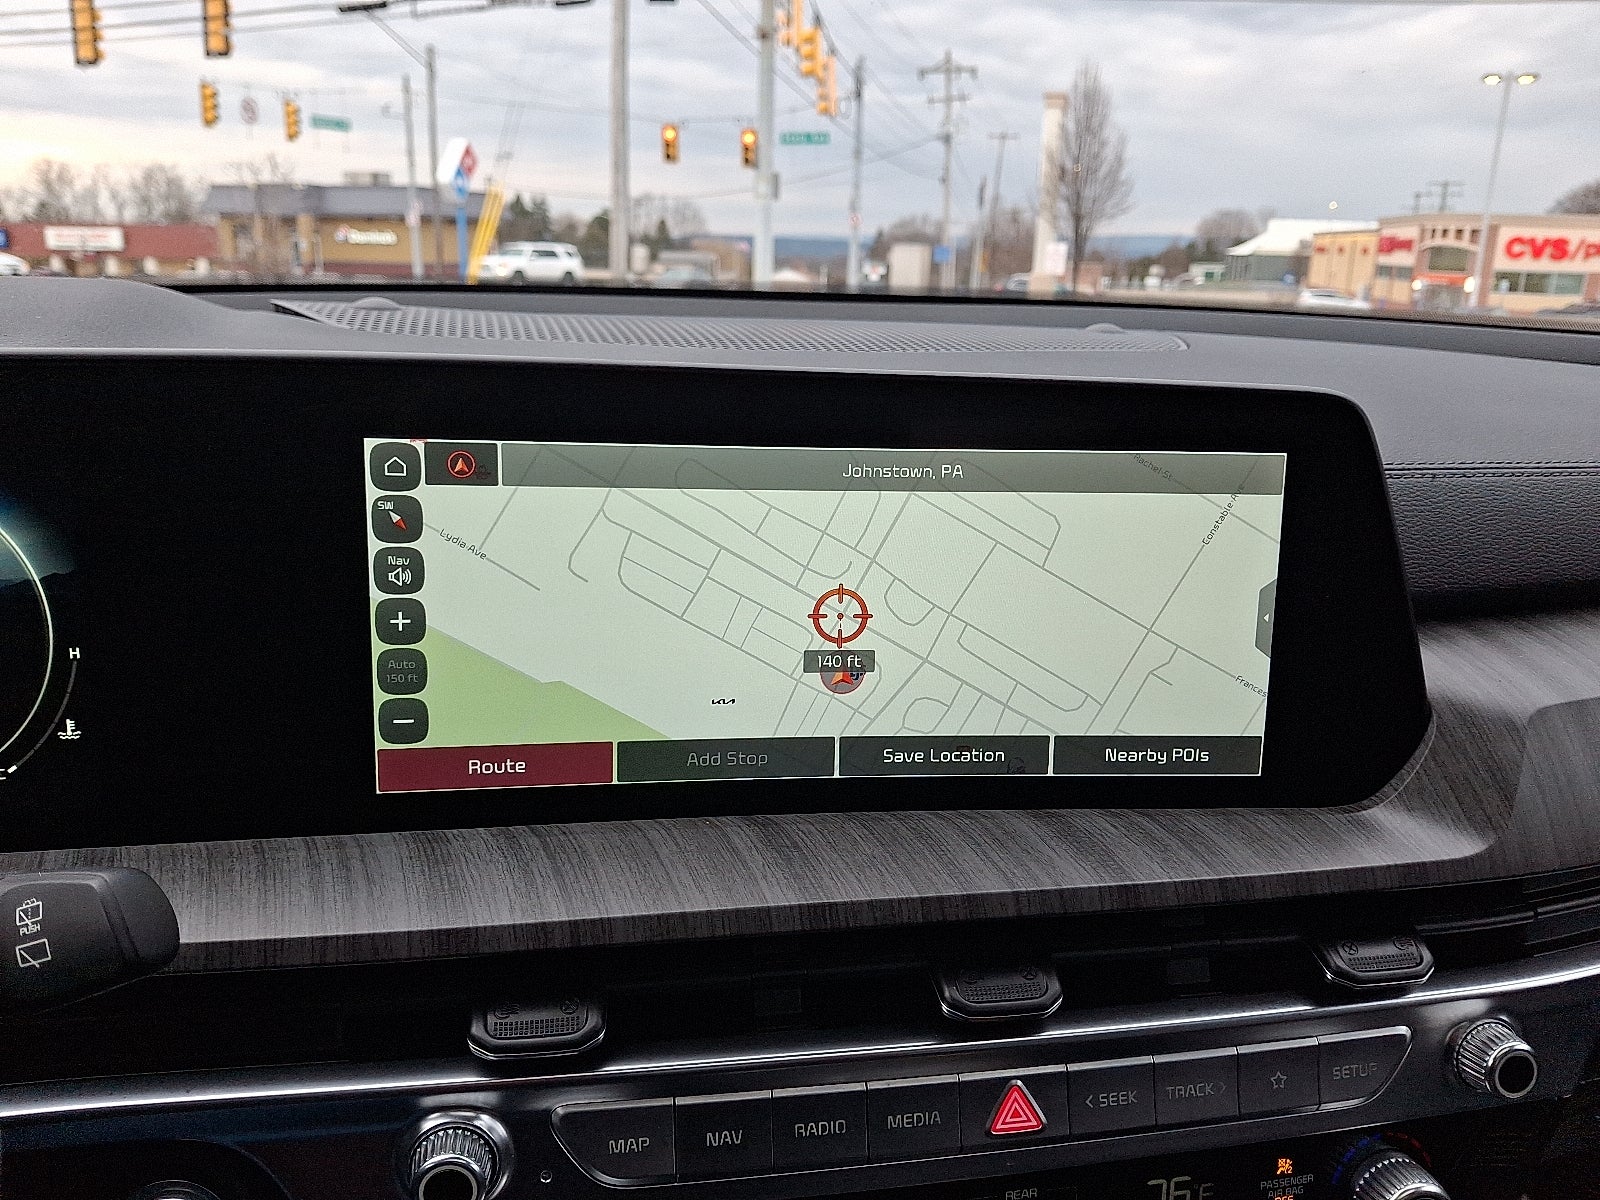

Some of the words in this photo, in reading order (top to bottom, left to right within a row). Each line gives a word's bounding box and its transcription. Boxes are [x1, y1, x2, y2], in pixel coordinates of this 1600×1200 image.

[842, 463, 936, 480] Johnstown,
[941, 464, 964, 479] PA
[377, 500, 394, 510] SW
[1202, 502, 1233, 546] Constable
[1231, 484, 1246, 502] Ave
[439, 528, 468, 550] Lydia
[466, 544, 487, 560] Ave
[387, 555, 410, 566] Nav
[69, 647, 81, 659] H
[817, 655, 842, 668] 140
[846, 655, 862, 668] ft
[388, 660, 416, 670] Auto
[386, 674, 405, 683] 150
[407, 673, 418, 683] ft
[1235, 675, 1268, 698] Frances
[687, 752, 722, 767] Add
[727, 751, 768, 767] Stop
[883, 748, 924, 763] Save
[930, 748, 1005, 763] Location
[1105, 748, 1167, 764] Nearby
[1172, 748, 1209, 762] POIs
[468, 758, 526, 775] Route
[19, 923, 41, 936] PUSH
[1332, 1062, 1378, 1080] SETUP
[1099, 1089, 1138, 1107] SEEK
[1166, 1082, 1215, 1100] TRACK
[887, 1110, 942, 1130] MEDIA
[794, 1120, 847, 1138] RADIO
[608, 1136, 650, 1155] MAP
[706, 1129, 743, 1147] NAV
[1260, 1173, 1314, 1190] PASSENGER
[1005, 1188, 1038, 1200] REAR
[1268, 1188, 1284, 1199] AIR
[1286, 1186, 1304, 1196] BAG
